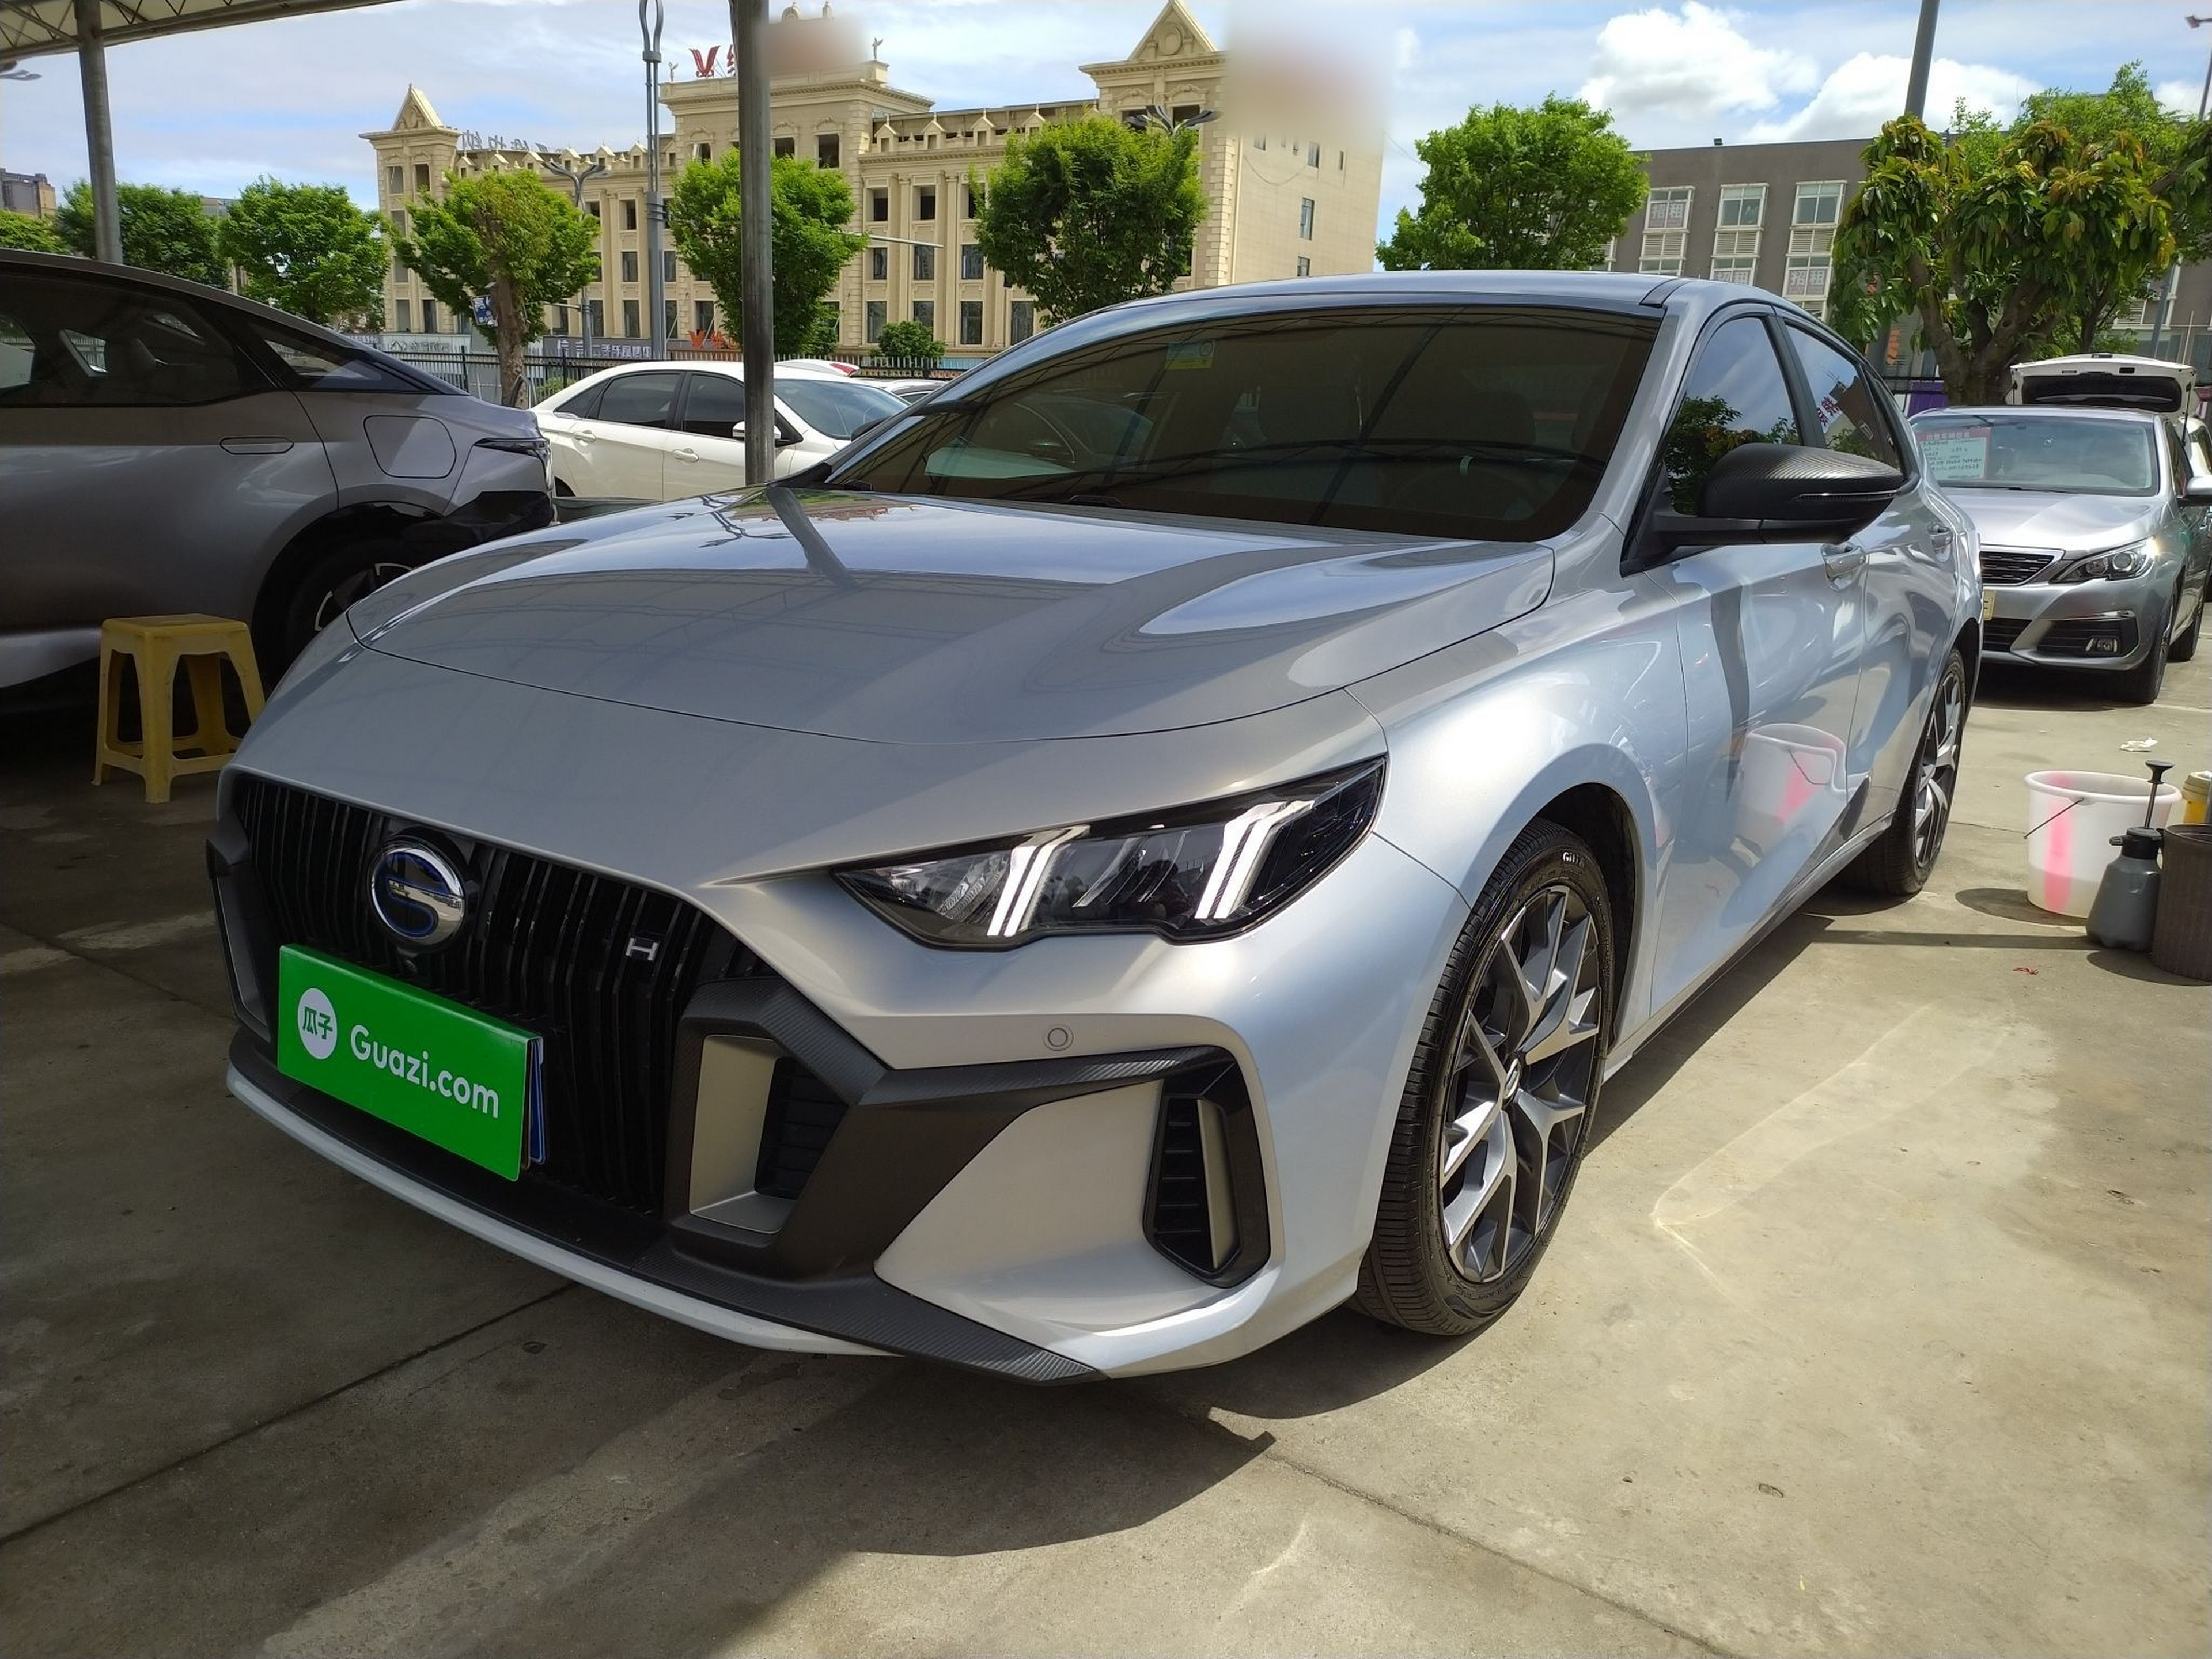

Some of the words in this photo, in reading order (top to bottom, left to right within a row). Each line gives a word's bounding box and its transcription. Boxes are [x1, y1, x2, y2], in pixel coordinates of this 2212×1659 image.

[1790, 270, 1825, 286] 招租
[626, 938, 657, 961] H
[302, 1006, 333, 1040] 瓜子
[350, 1024, 499, 1118] Guazi.com
